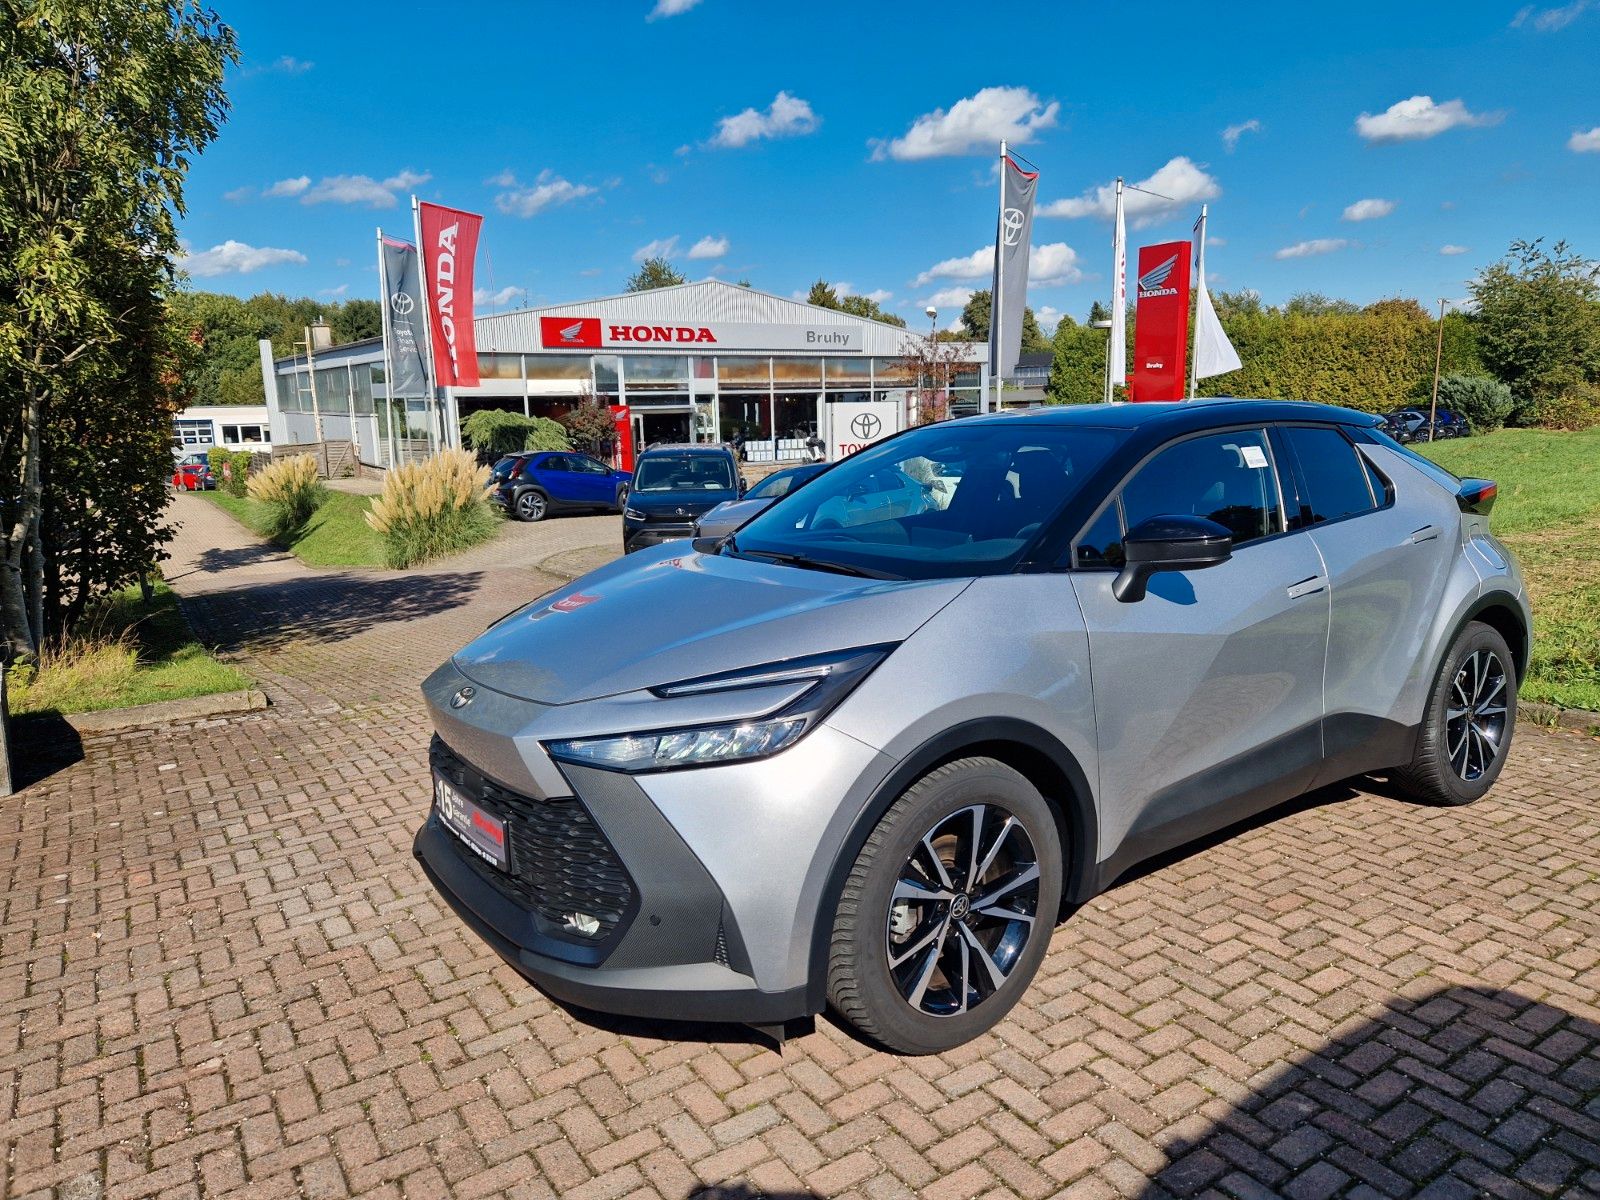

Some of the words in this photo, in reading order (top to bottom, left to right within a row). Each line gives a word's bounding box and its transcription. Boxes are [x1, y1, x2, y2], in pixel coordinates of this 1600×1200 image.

[1139, 287, 1178, 298] HONDA
[609, 325, 717, 343] HONDA
[806, 331, 850, 346] Bruhy
[839, 443, 873, 457] TOY
[438, 780, 453, 820] 15
